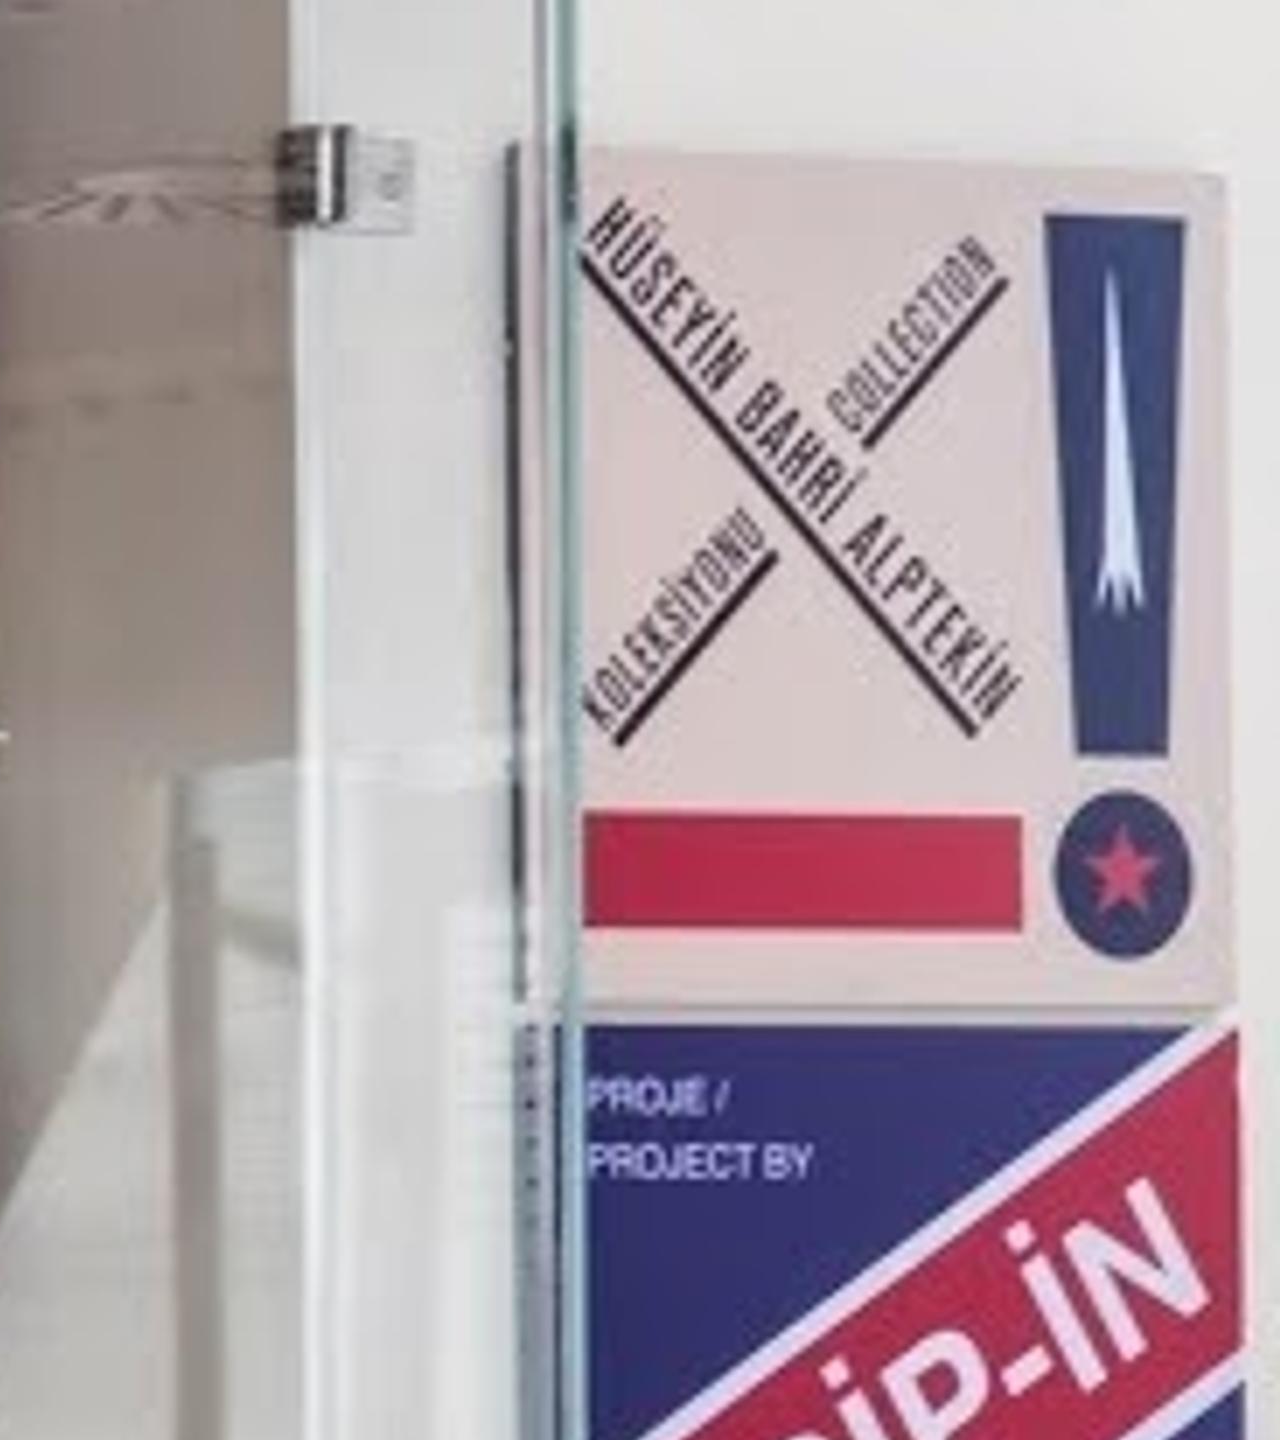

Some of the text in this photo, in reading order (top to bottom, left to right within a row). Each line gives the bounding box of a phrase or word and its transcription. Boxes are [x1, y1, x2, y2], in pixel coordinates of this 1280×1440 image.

[826, 234, 1001, 437] COLLECTION
[585, 197, 1025, 722] HÜSEYİN BAHRİ ALPTEKİN
[582, 506, 766, 732] KOLEKSİYONU
[587, 1075, 707, 1116] PROJE
[587, 1141, 816, 1181] PROJECT BY
